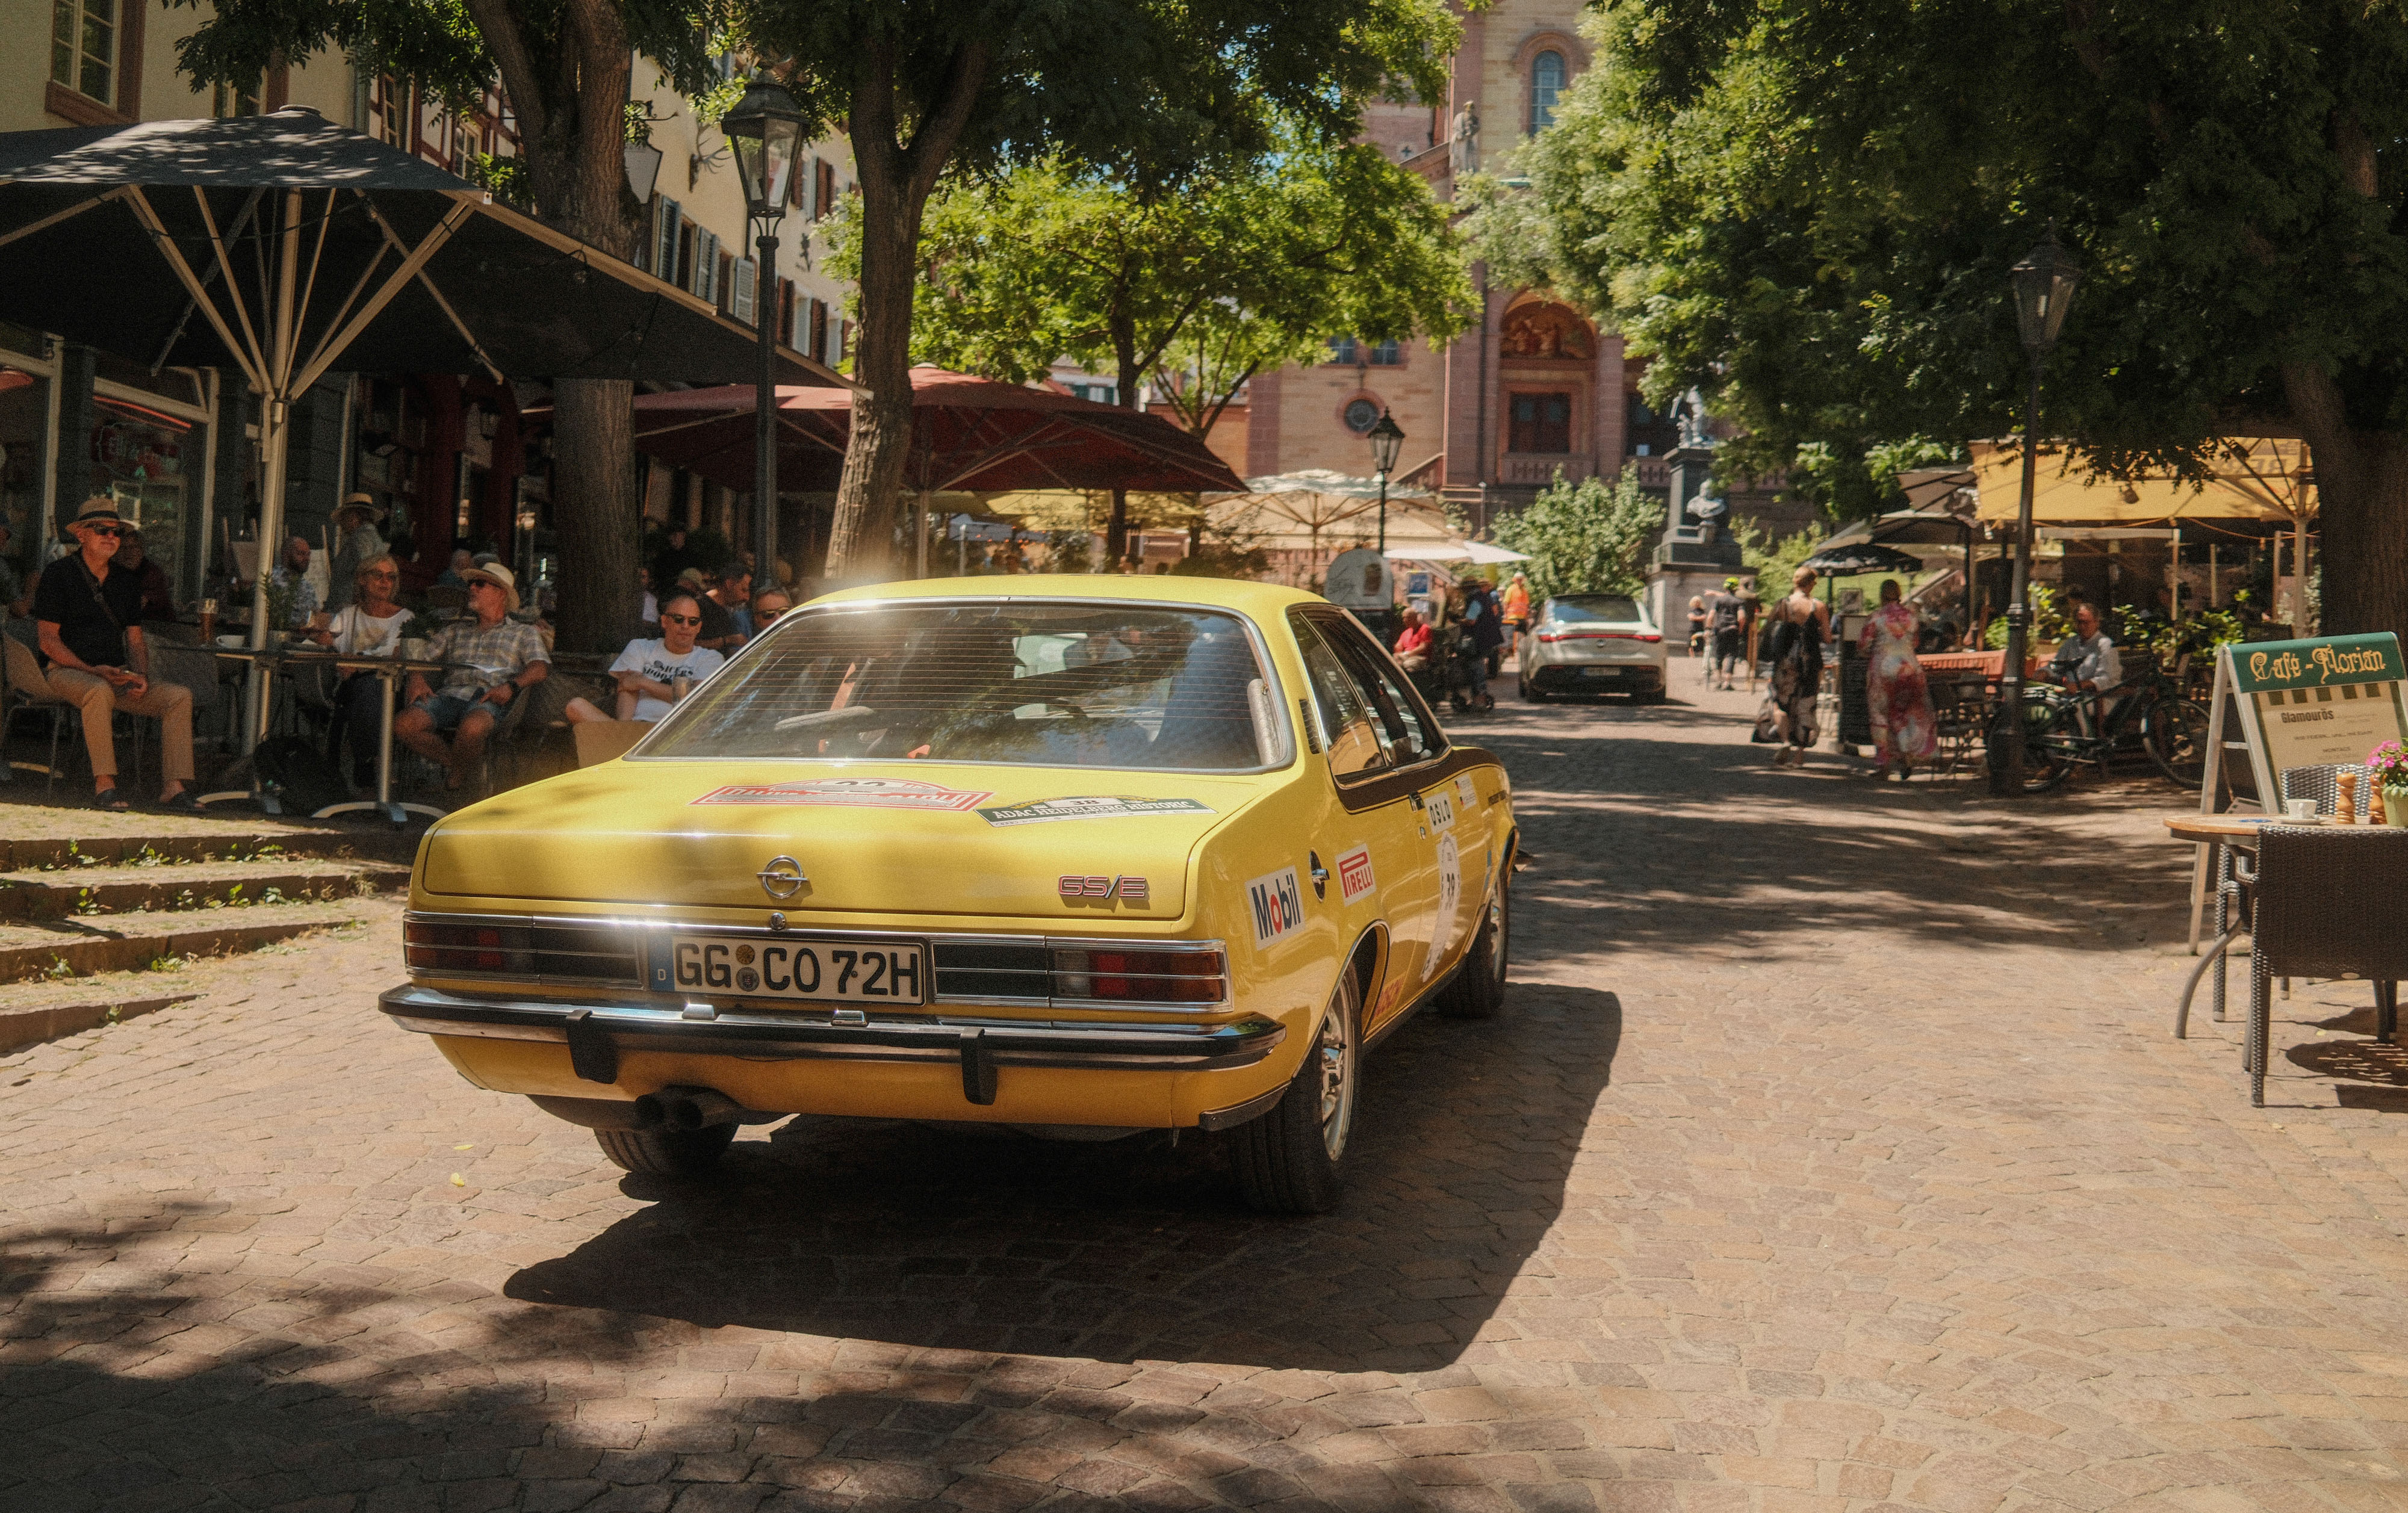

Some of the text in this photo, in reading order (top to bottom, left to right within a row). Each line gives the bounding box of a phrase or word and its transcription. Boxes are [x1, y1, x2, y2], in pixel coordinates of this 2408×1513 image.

[2250, 651, 2302, 682] Café
[2312, 644, 2386, 684] Florian
[2280, 708, 2335, 723] Glamourös
[993, 809, 1037, 819] ADAC
[1034, 805, 1127, 815] HEIDELBERG
[1125, 801, 1194, 810] HISTORIC
[1429, 799, 1451, 826] OSLO
[1058, 874, 1146, 899] GS/E
[1338, 851, 1373, 898] PIRELLI
[1251, 873, 1301, 940] Mobil
[657, 969, 666, 981] D
[675, 942, 919, 997] GG CO 72H
